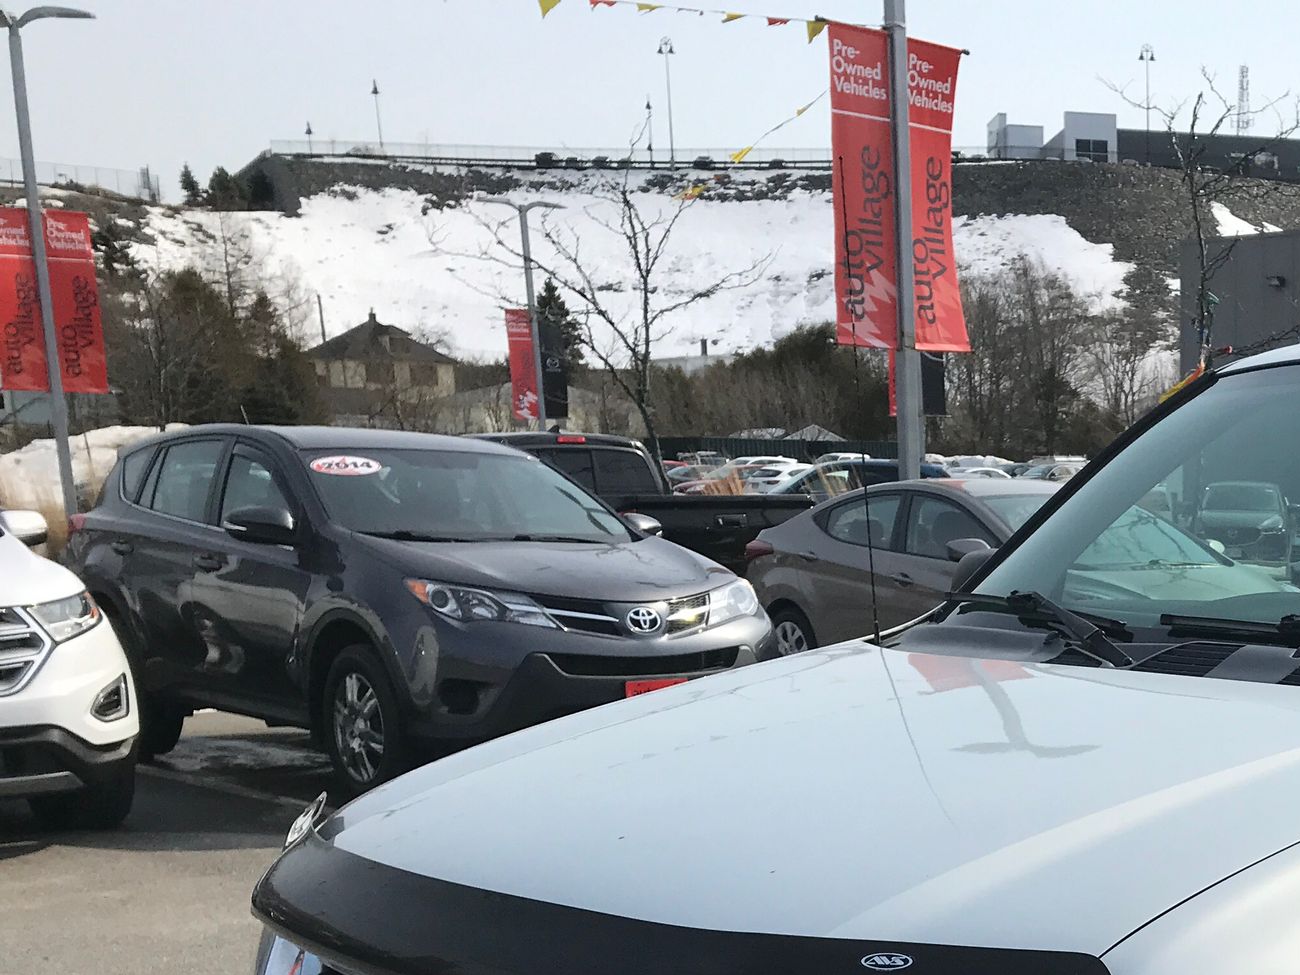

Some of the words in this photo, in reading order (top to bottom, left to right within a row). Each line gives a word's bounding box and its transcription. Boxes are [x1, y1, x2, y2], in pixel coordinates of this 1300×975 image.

[833, 39, 860, 59] Pre-
[833, 56, 882, 80] Owned
[909, 53, 934, 73] Pre-
[833, 75, 887, 100] Vehicles
[907, 88, 953, 113] Vehicles
[908, 70, 951, 94] Owned
[858, 144, 893, 273] village
[922, 156, 949, 281] village
[839, 229, 865, 321] auto
[912, 239, 936, 325] auto
[72, 275, 97, 348] village
[61, 324, 82, 378] auto
